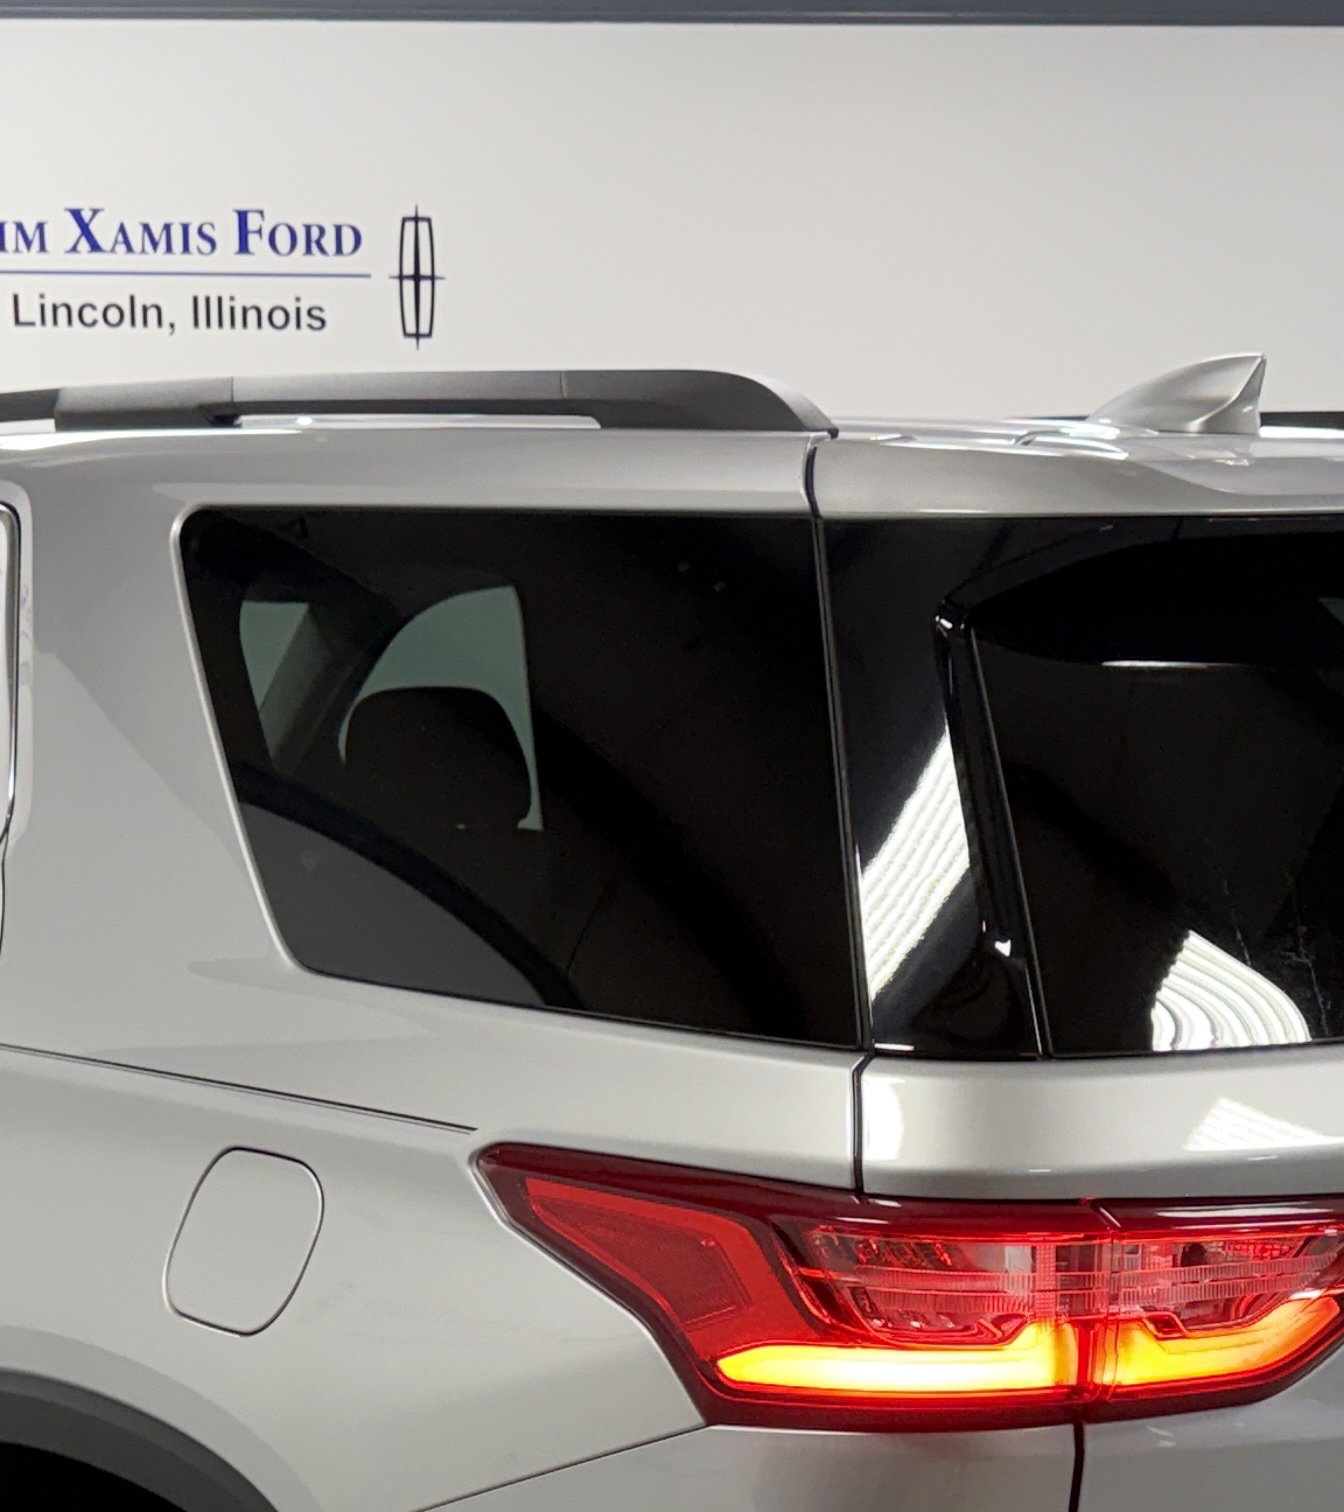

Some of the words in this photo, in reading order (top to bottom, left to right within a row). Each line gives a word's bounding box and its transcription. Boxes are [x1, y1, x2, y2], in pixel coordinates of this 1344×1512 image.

[63, 208, 217, 256] XAMIS
[233, 209, 362, 257] FORD
[12, 293, 175, 336] Lincoln,
[191, 295, 328, 332] Illinois
